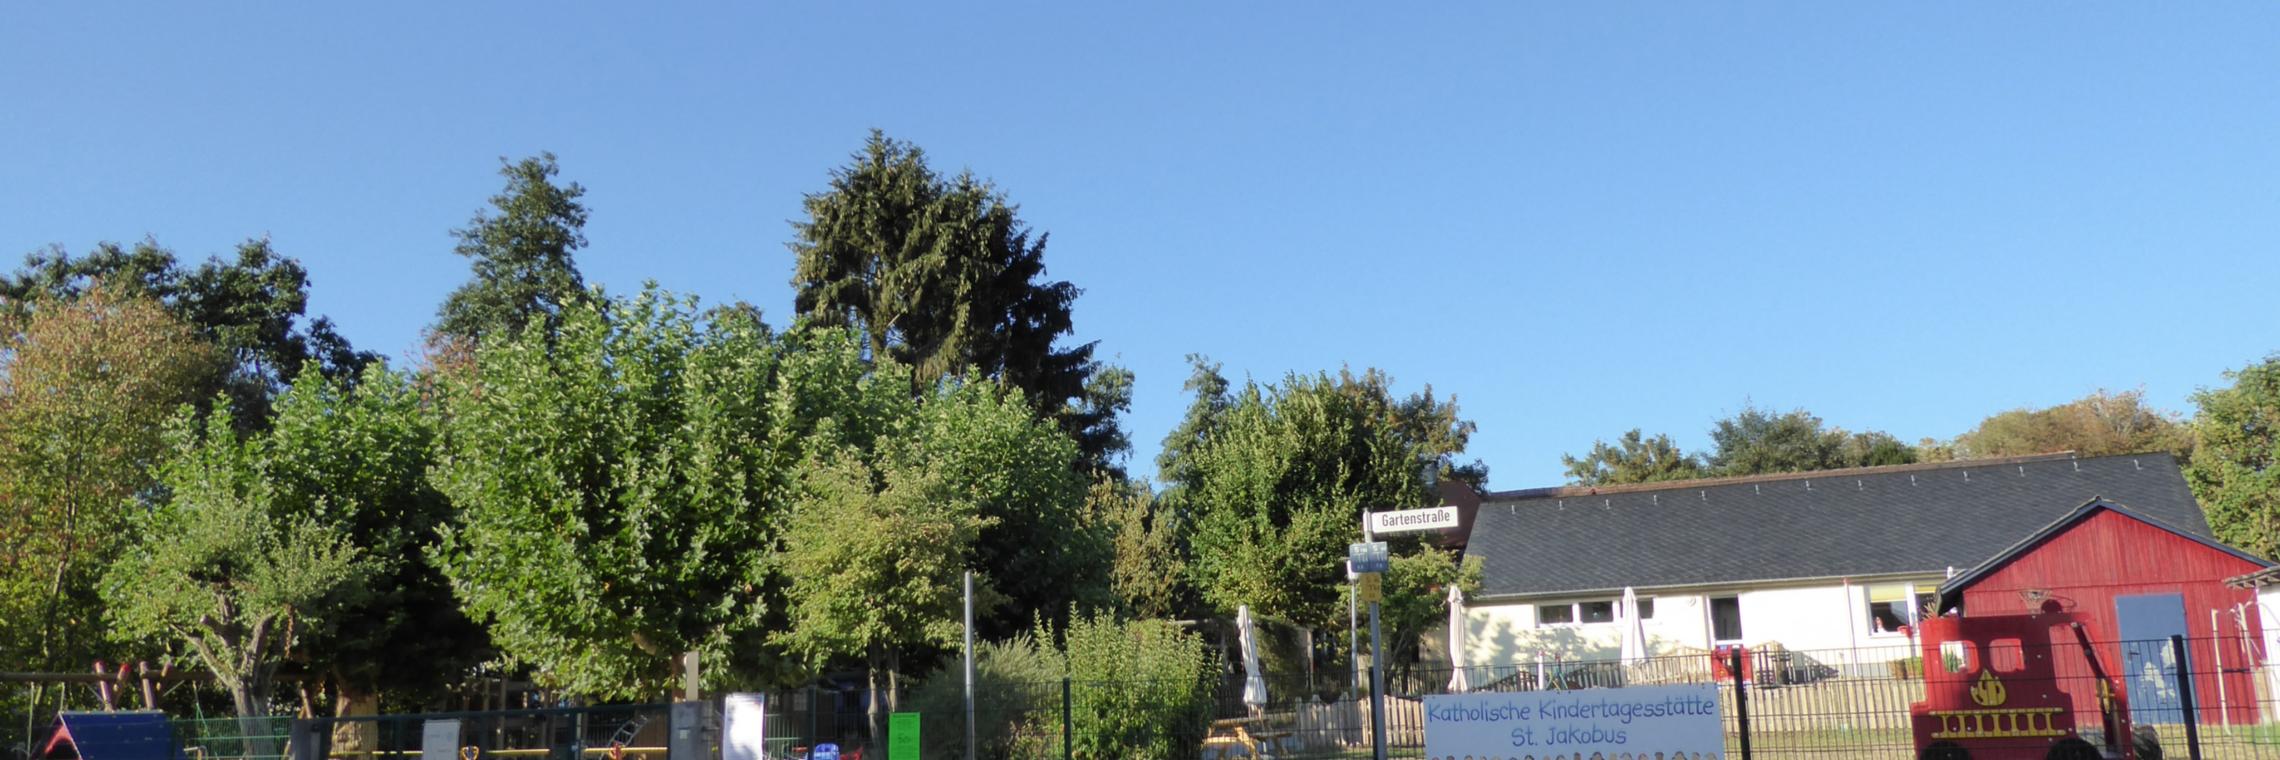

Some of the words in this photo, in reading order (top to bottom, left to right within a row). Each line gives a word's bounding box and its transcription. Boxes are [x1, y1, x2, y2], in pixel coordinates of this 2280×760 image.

[1381, 509, 1450, 527] Gartenstraße
[1428, 700, 1531, 722] Katholische
[1539, 695, 1715, 724] Kindertagesstätte
[1511, 724, 1538, 747] St.
[1546, 722, 1627, 745] Jakobus
